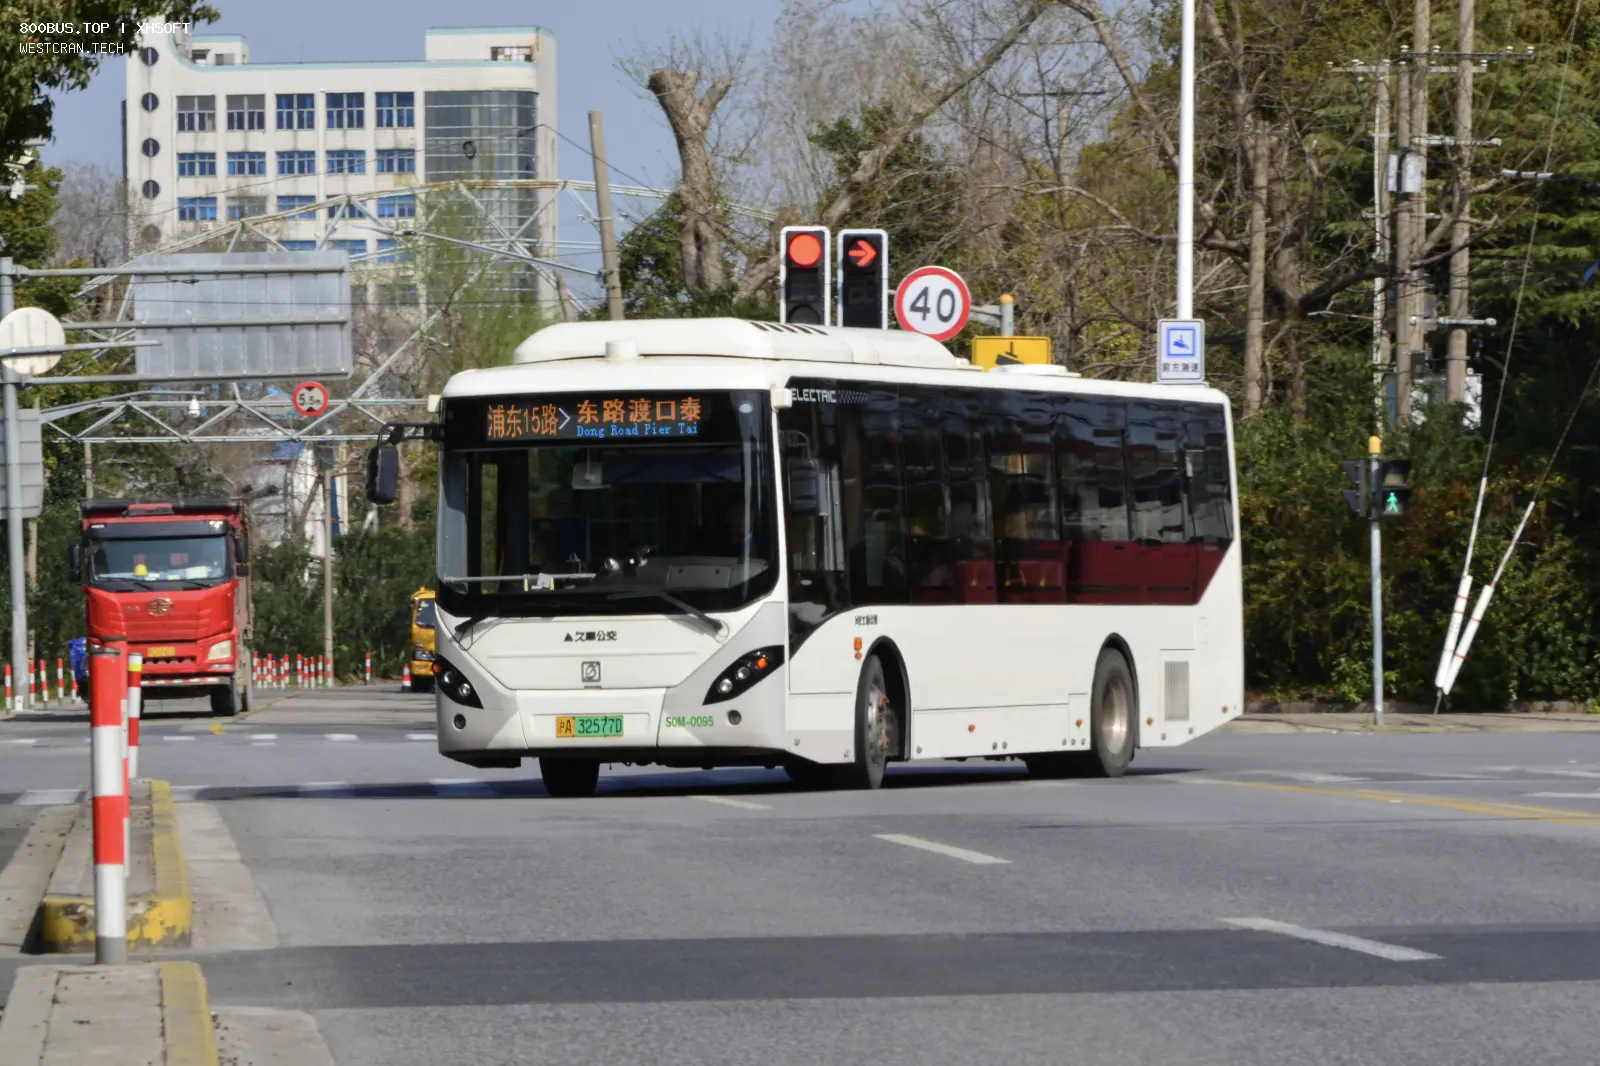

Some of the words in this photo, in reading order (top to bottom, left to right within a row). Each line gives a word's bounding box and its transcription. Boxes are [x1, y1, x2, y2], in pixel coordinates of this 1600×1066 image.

[909, 286, 956, 323] 40
[790, 388, 837, 403] ELECTRIC
[487, 403, 558, 439] 浦东15路
[577, 396, 702, 424] 东路渡口泰
[576, 425, 605, 439] Dong
[611, 423, 639, 436] Road
[644, 423, 671, 436] Pier
[679, 422, 698, 434] Tai
